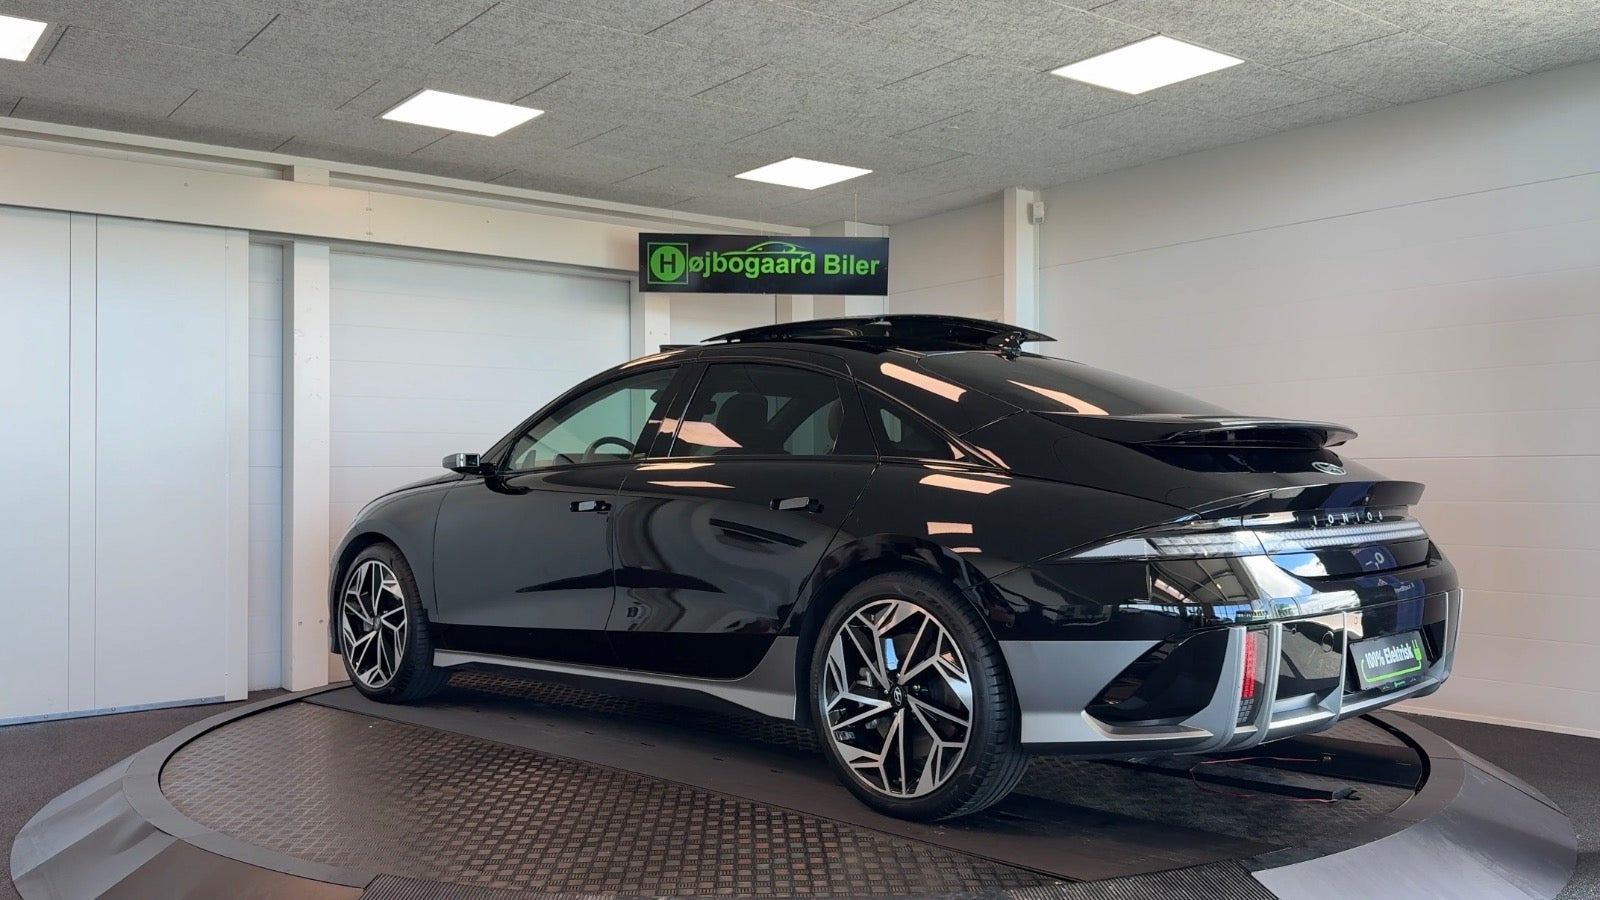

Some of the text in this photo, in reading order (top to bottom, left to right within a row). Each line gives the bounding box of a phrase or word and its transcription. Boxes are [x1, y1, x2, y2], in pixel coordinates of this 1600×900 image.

[823, 254, 880, 275] Biler
[1364, 642, 1414, 669] 100% Elektrisk
